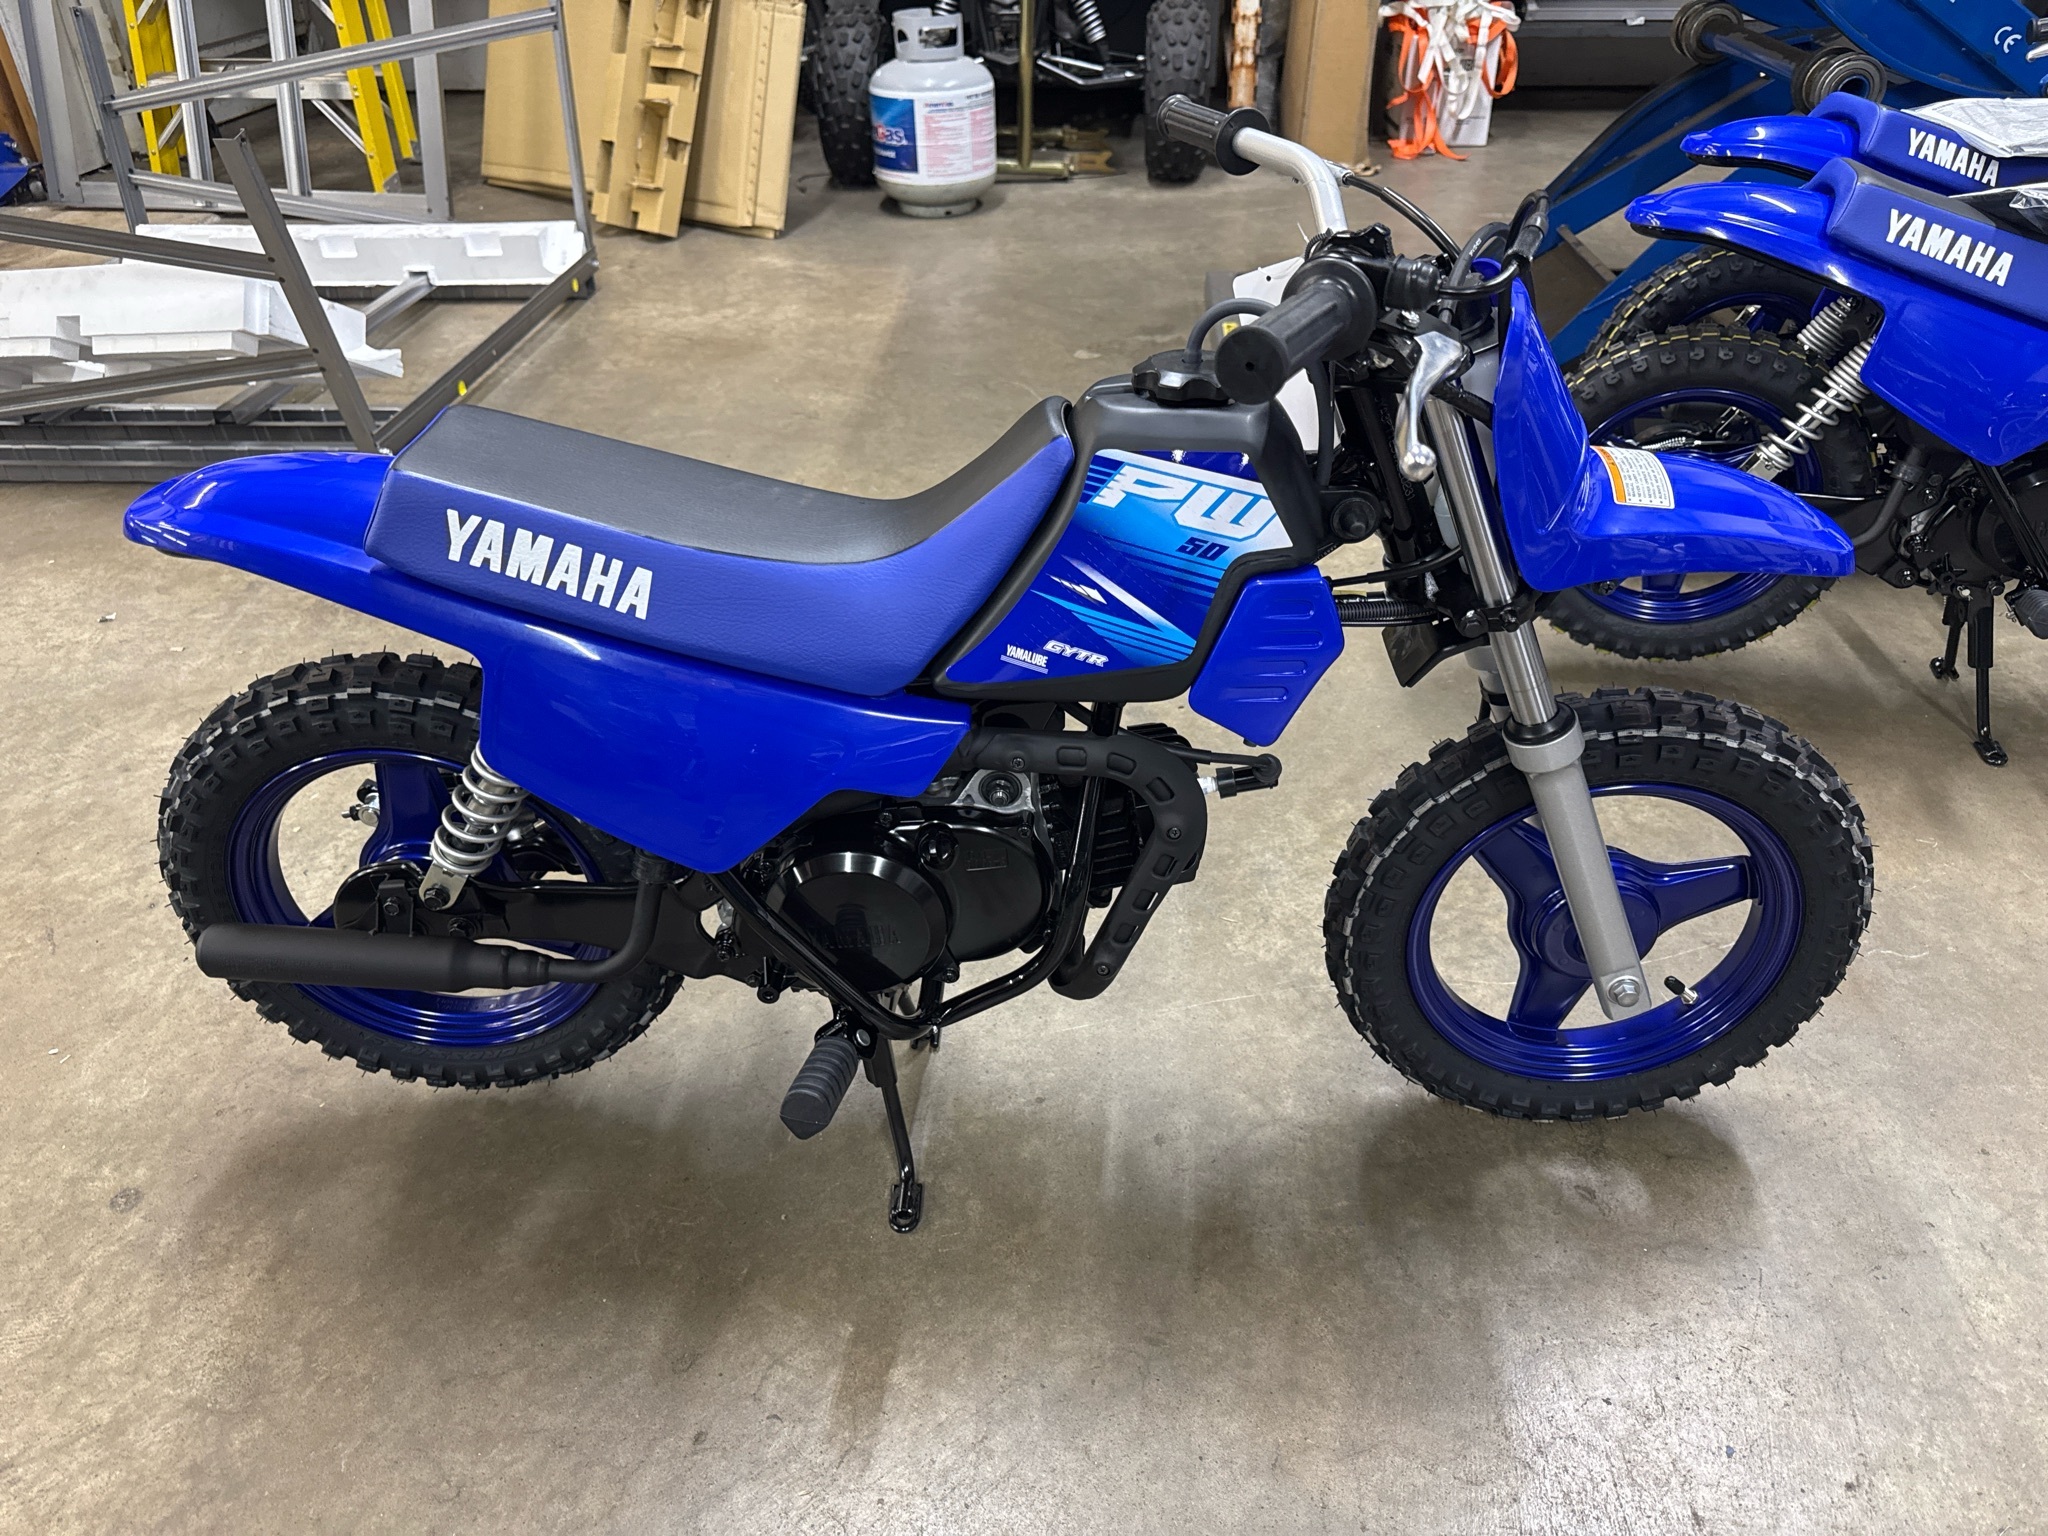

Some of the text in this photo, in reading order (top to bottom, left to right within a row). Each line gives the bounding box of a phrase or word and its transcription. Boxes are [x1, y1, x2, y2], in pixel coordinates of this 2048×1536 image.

[1908, 127, 1999, 187] YAMAHA
[1885, 208, 2014, 287] YAMAHA
[1091, 464, 1276, 542] PW
[446, 508, 653, 621] YAMAHA
[1175, 536, 1230, 561] 50
[1006, 643, 1049, 668] YAMALUBE
[1043, 640, 1109, 668] GYTR
